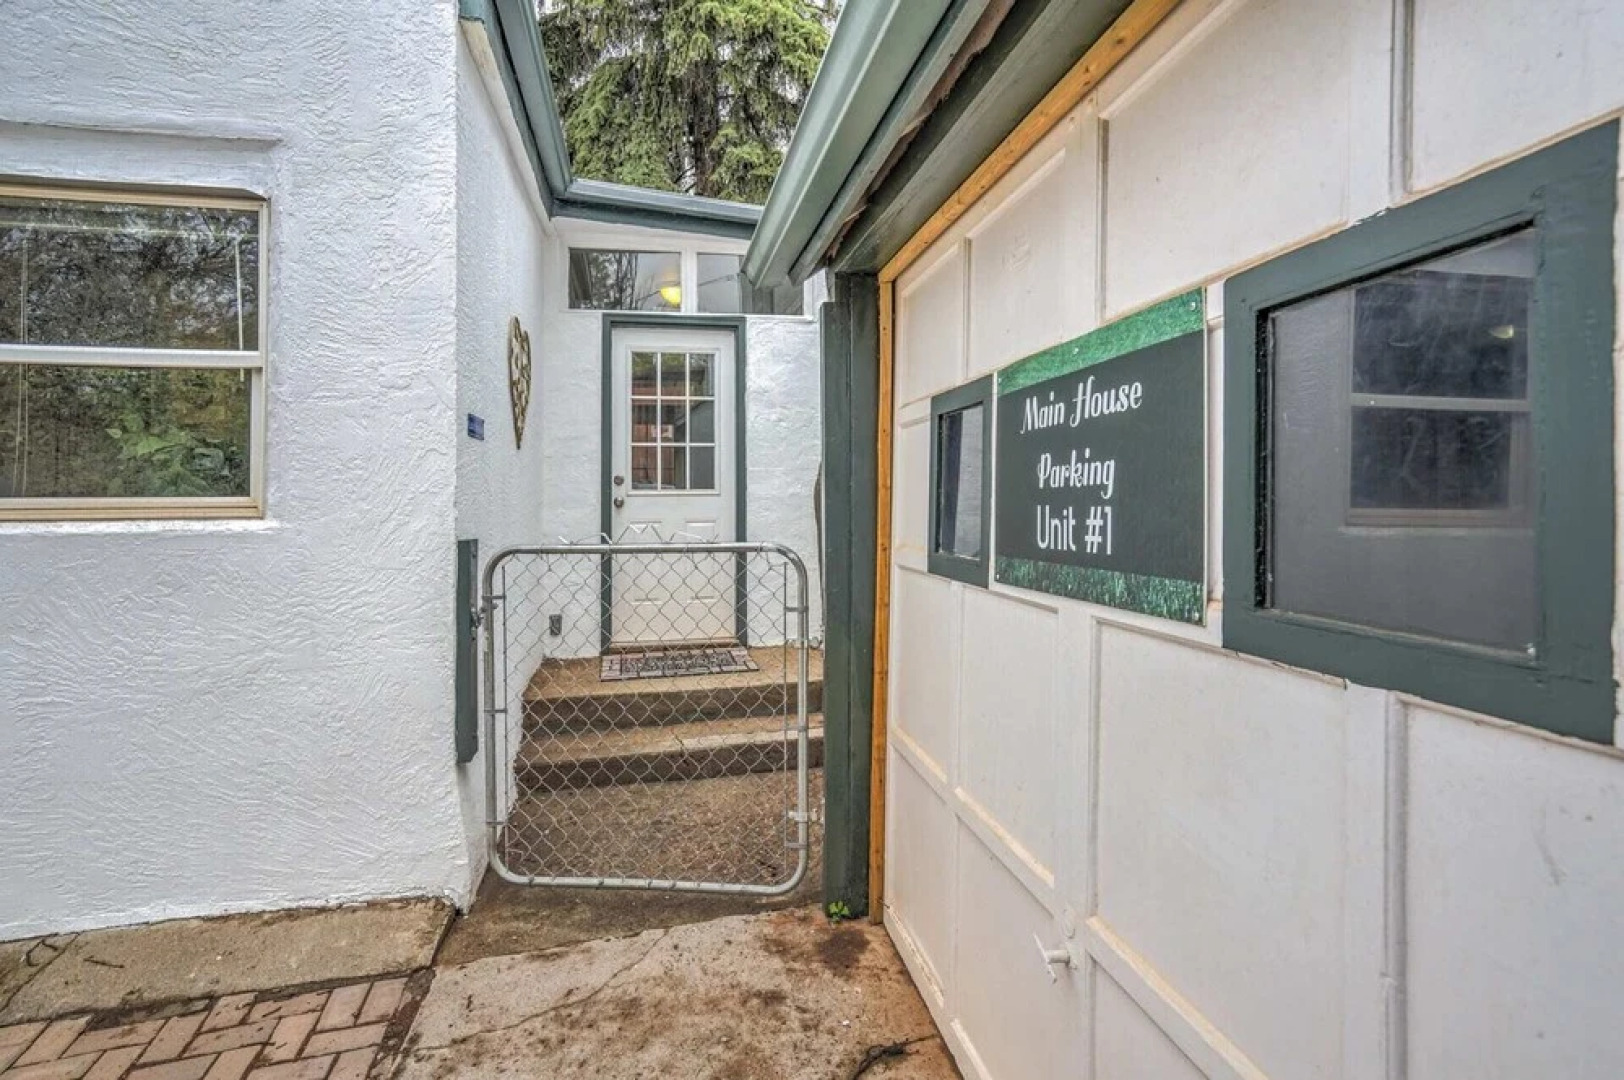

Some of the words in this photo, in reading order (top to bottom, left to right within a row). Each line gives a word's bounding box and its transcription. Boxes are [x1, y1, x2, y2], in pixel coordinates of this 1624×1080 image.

[1020, 390, 1065, 434] Main
[1069, 375, 1142, 428] House
[1037, 448, 1115, 499] Parking
[1037, 504, 1076, 551] Unit
[1084, 506, 1112, 555] #1
